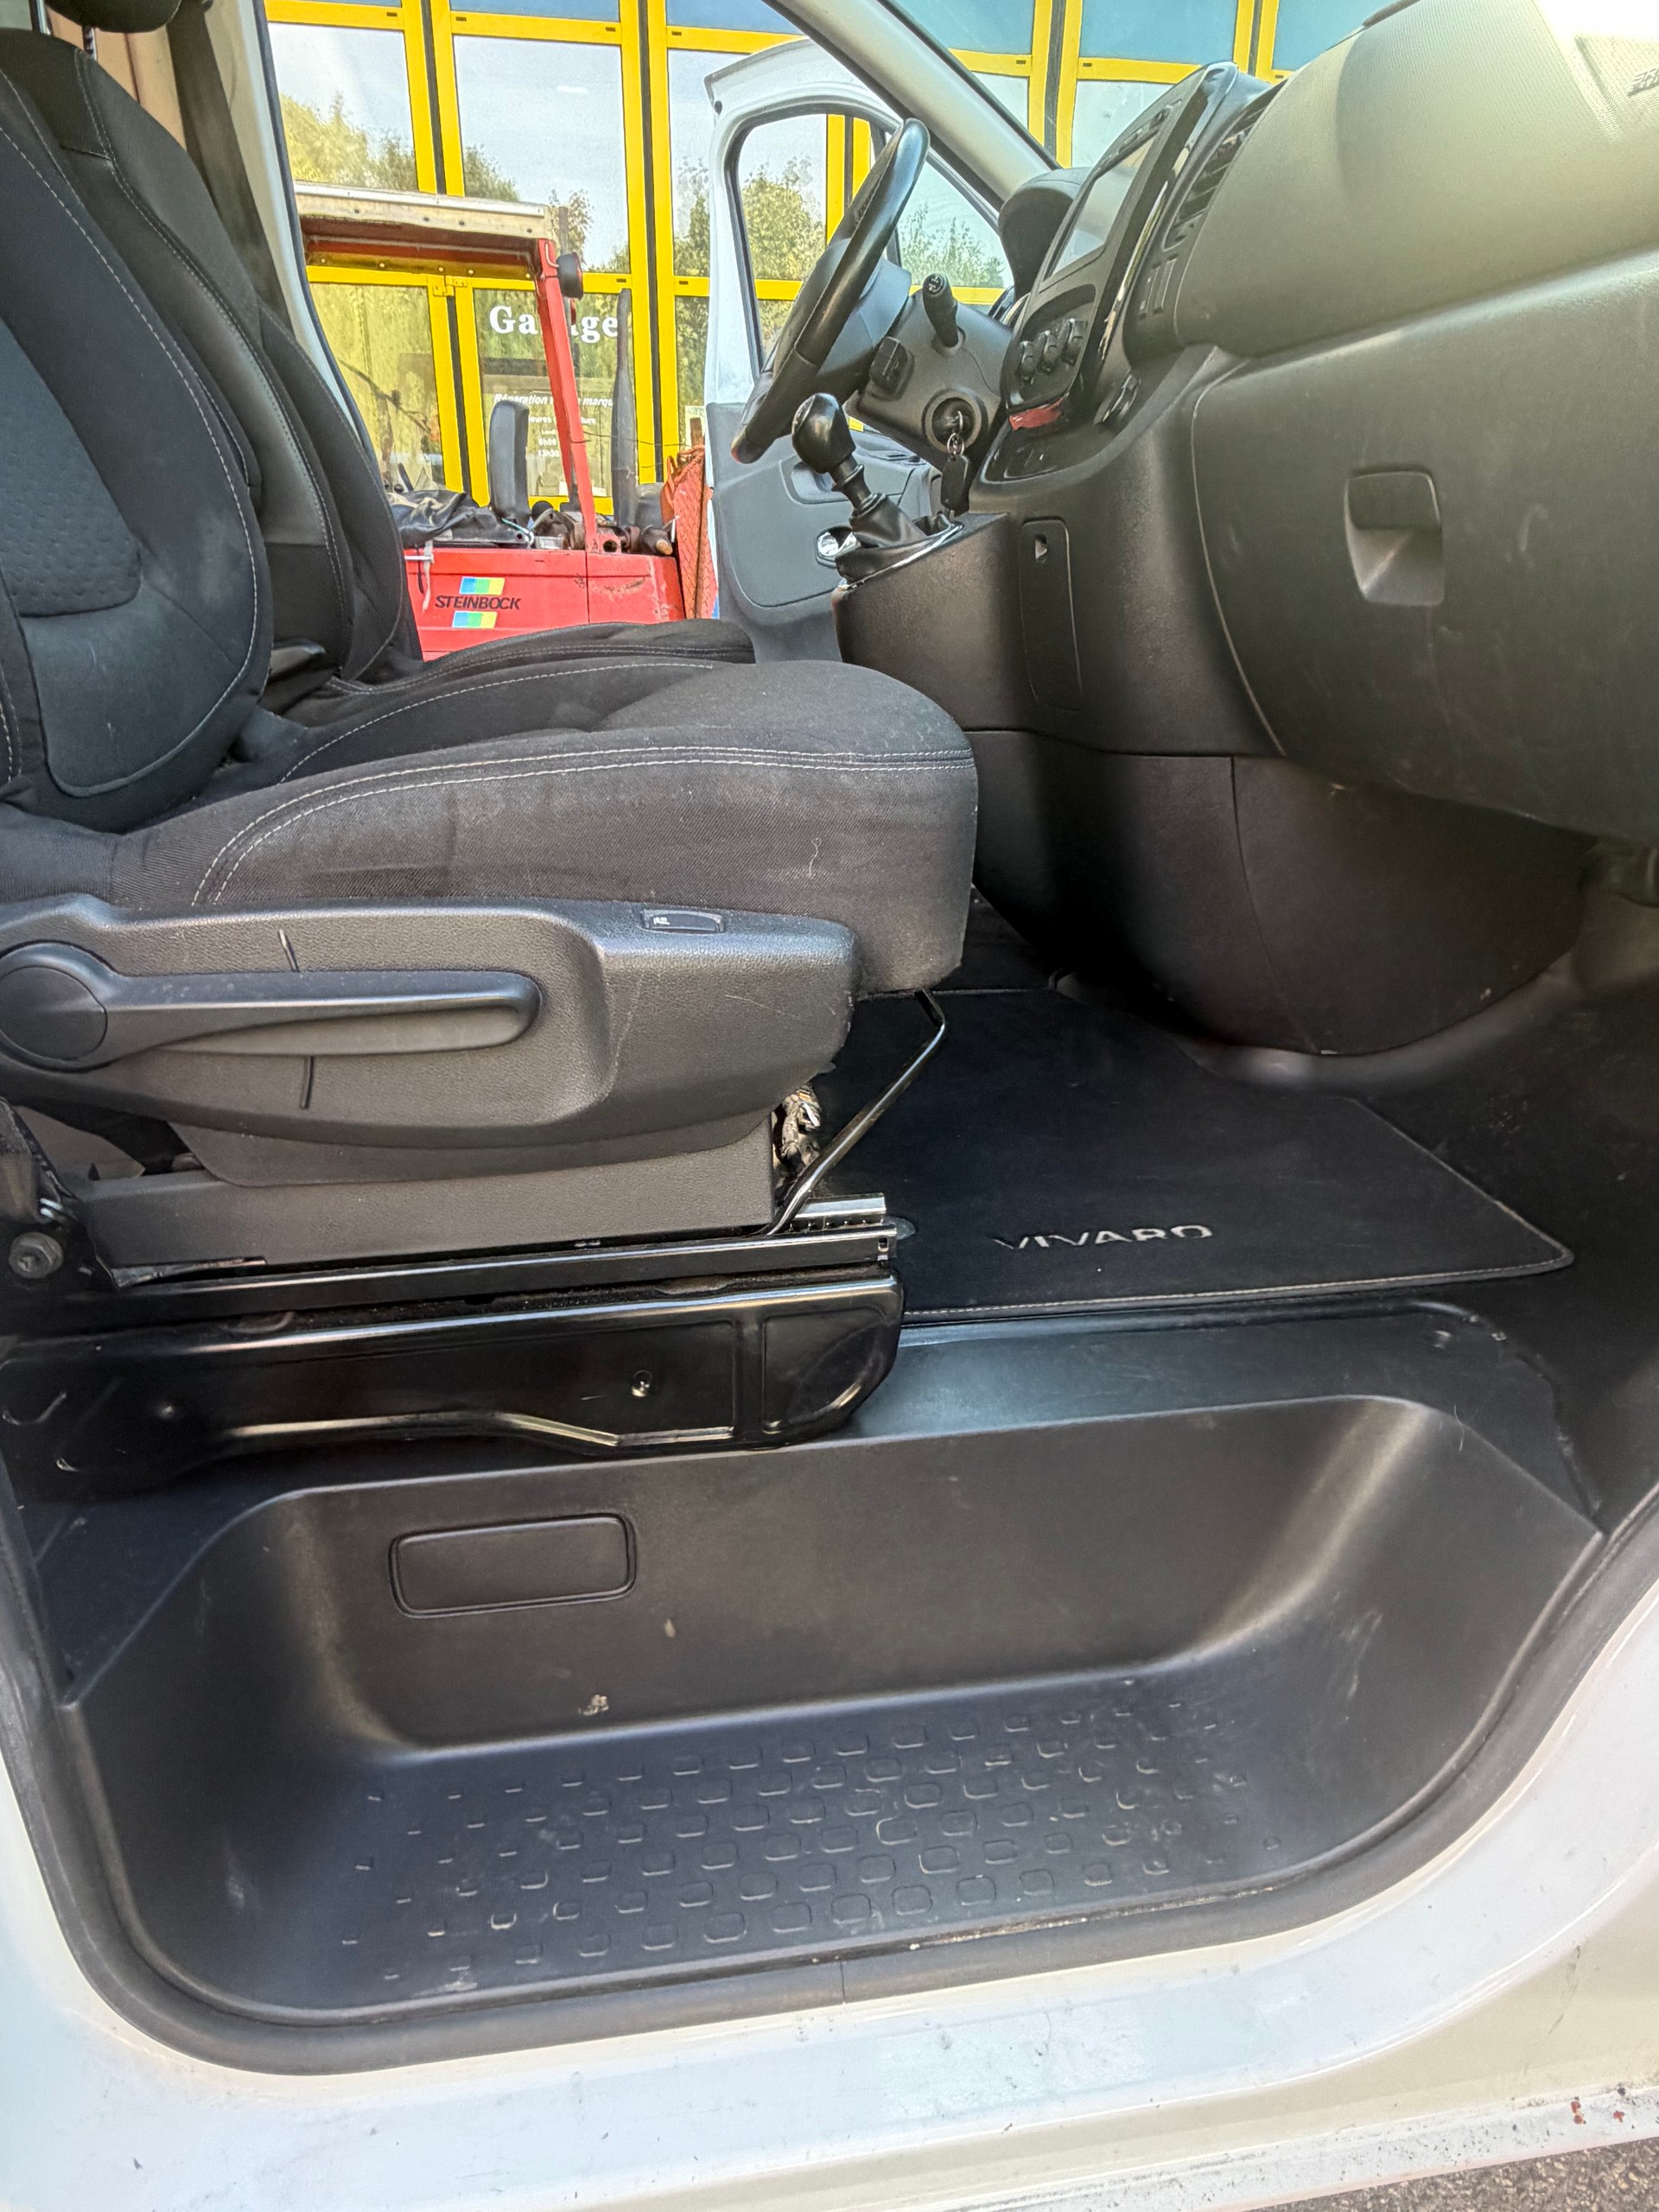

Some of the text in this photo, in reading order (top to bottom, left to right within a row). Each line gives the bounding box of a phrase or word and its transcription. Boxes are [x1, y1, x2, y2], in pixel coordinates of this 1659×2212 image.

[489, 305, 618, 344] Gage
[582, 397, 613, 408] marqu
[435, 594, 522, 610] STEINBOCK
[993, 1224, 1213, 1250] VIVARO
